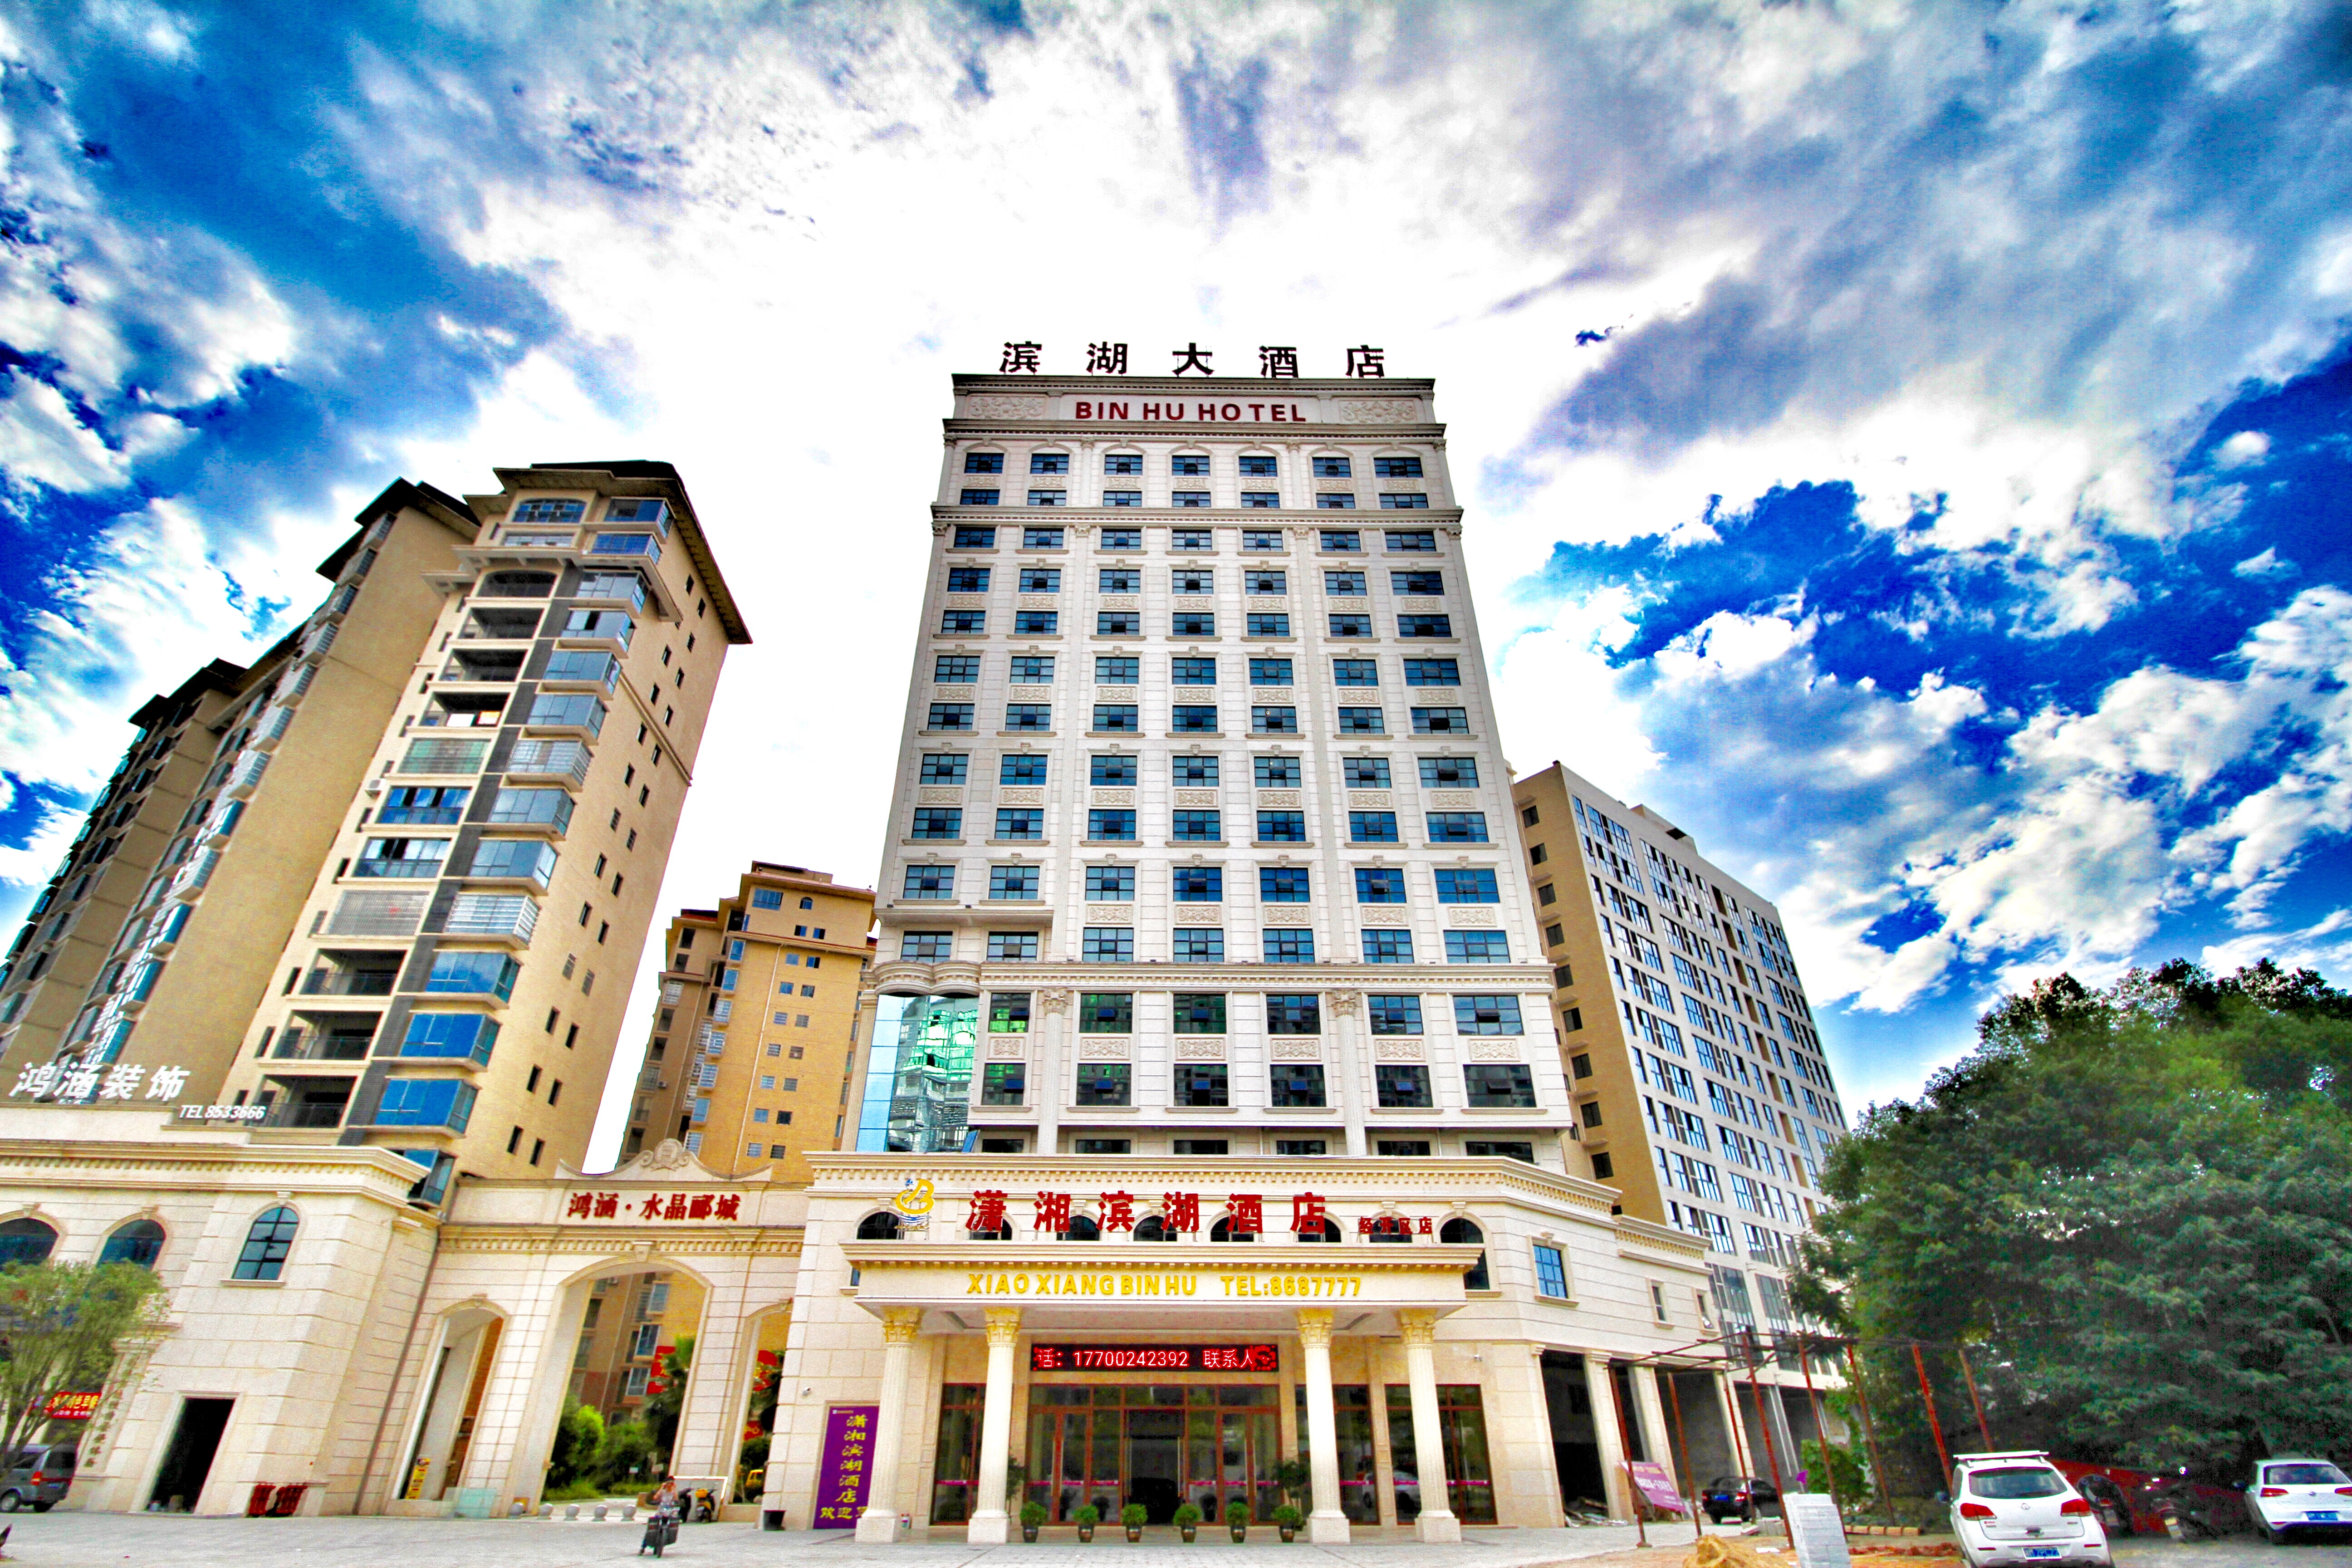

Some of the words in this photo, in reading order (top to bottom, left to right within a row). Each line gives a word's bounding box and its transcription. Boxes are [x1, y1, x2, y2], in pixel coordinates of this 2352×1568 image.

[999, 341, 1385, 377] 滨湖大酒店
[1075, 402, 1128, 420] BIN
[1142, 402, 1184, 421] HU
[1198, 403, 1306, 422] HOTEL
[8, 1061, 191, 1102] 鸿涵装饰
[179, 1104, 204, 1119] TEL
[205, 1105, 267, 1120] 8533666
[966, 1190, 1326, 1234] 潇湘滨湖酒店
[1359, 1216, 1433, 1235] 经开区店
[967, 1273, 1029, 1294] XIAO
[1035, 1274, 1115, 1295] XIANG
[1120, 1274, 1160, 1295] BIN
[1165, 1275, 1196, 1296] HU
[1220, 1275, 1361, 1296] TEL:8687777
[835, 1414, 868, 1503] 潇湘滨湖酒店
